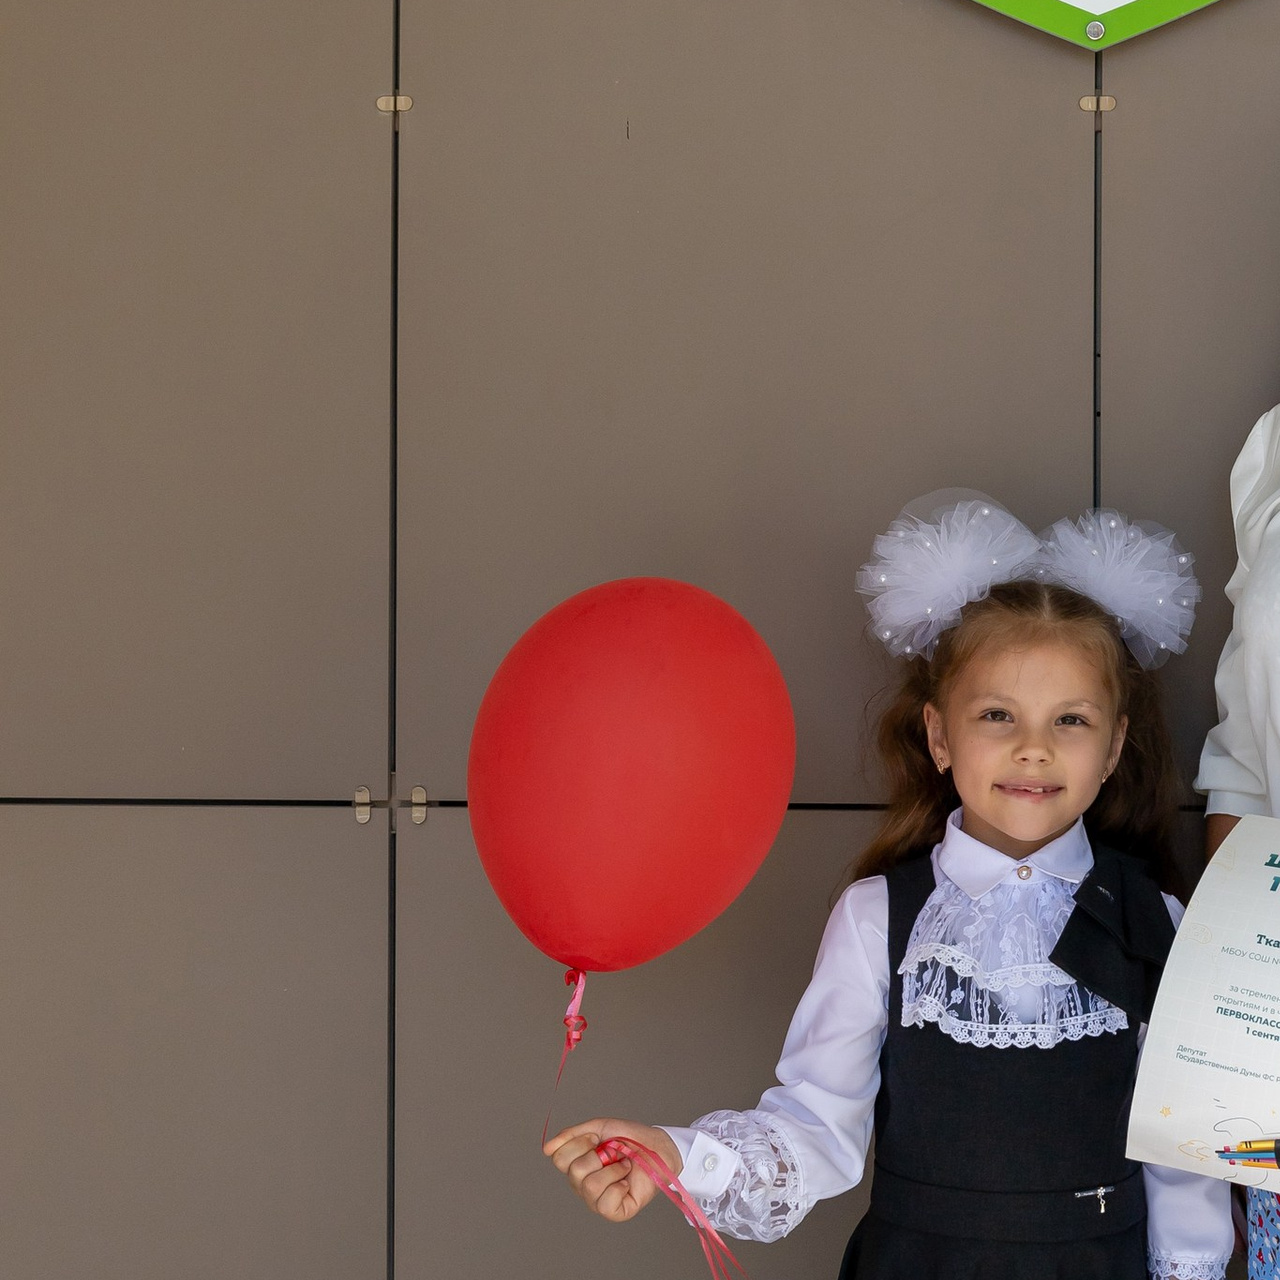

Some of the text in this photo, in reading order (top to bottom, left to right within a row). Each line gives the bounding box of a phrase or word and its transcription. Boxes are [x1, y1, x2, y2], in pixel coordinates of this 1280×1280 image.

[1220, 946, 1247, 958] МБОУ
[1248, 951, 1271, 964] СОШ
[1229, 985, 1239, 993] за
[1213, 993, 1261, 1011] открытиям
[1245, 1026, 1250, 1035] 1
[1176, 1044, 1208, 1058] Депутат
[1175, 1052, 1239, 1074] Государственной
[1239, 1067, 1262, 1080] Думы
[1262, 1071, 1275, 1082] ФС
